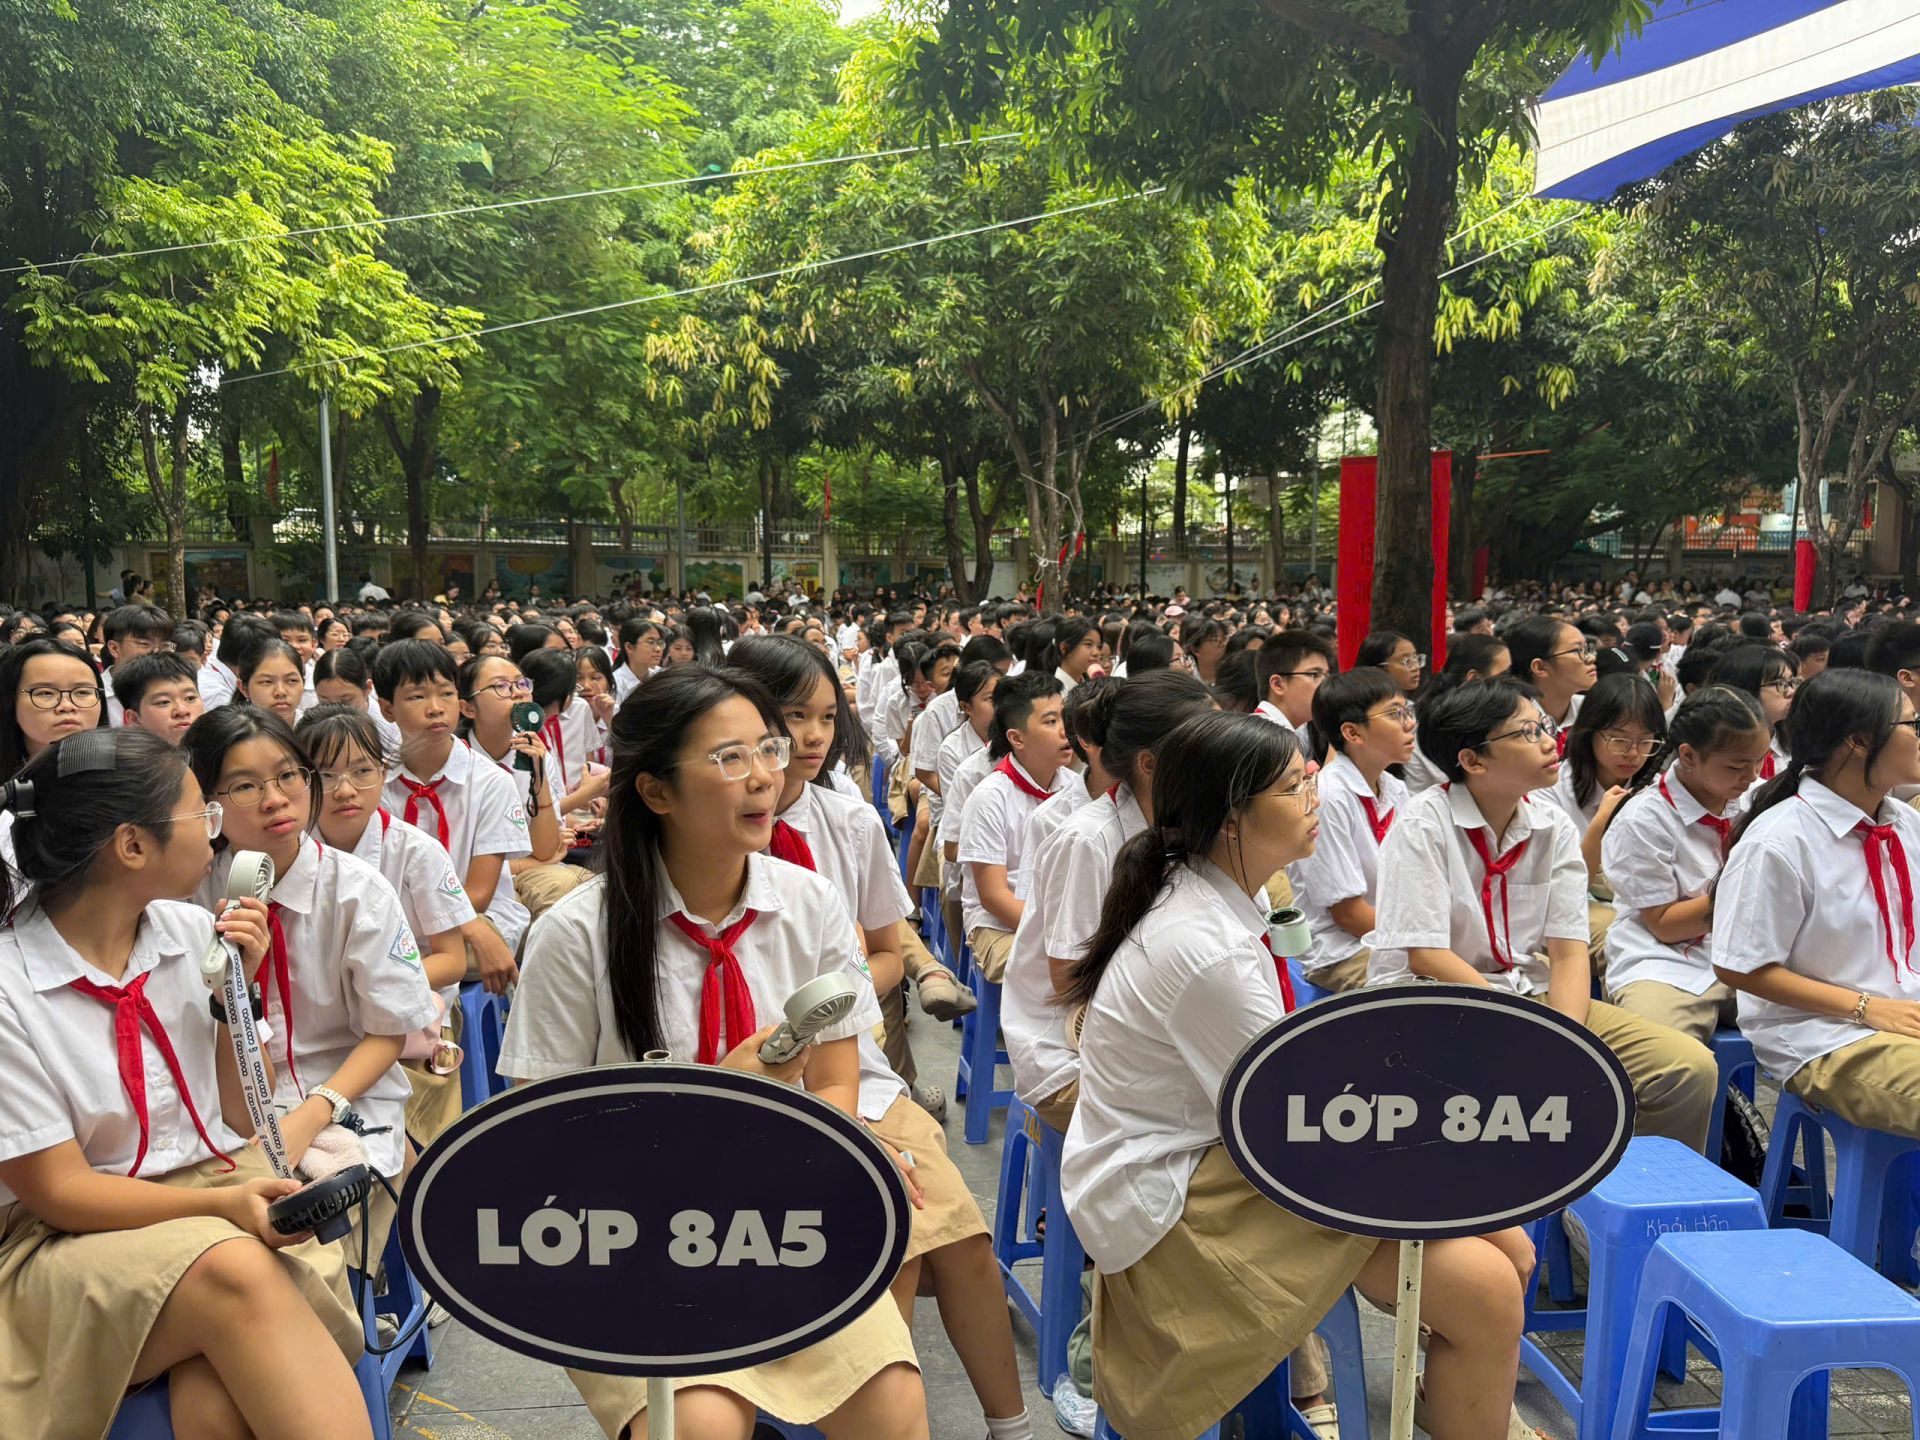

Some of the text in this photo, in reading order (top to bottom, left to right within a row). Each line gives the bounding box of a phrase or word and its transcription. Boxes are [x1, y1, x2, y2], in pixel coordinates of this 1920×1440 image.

[1286, 1083, 1572, 1144] LỚP 8A4
[476, 1195, 828, 1268] LỚP 8A5
